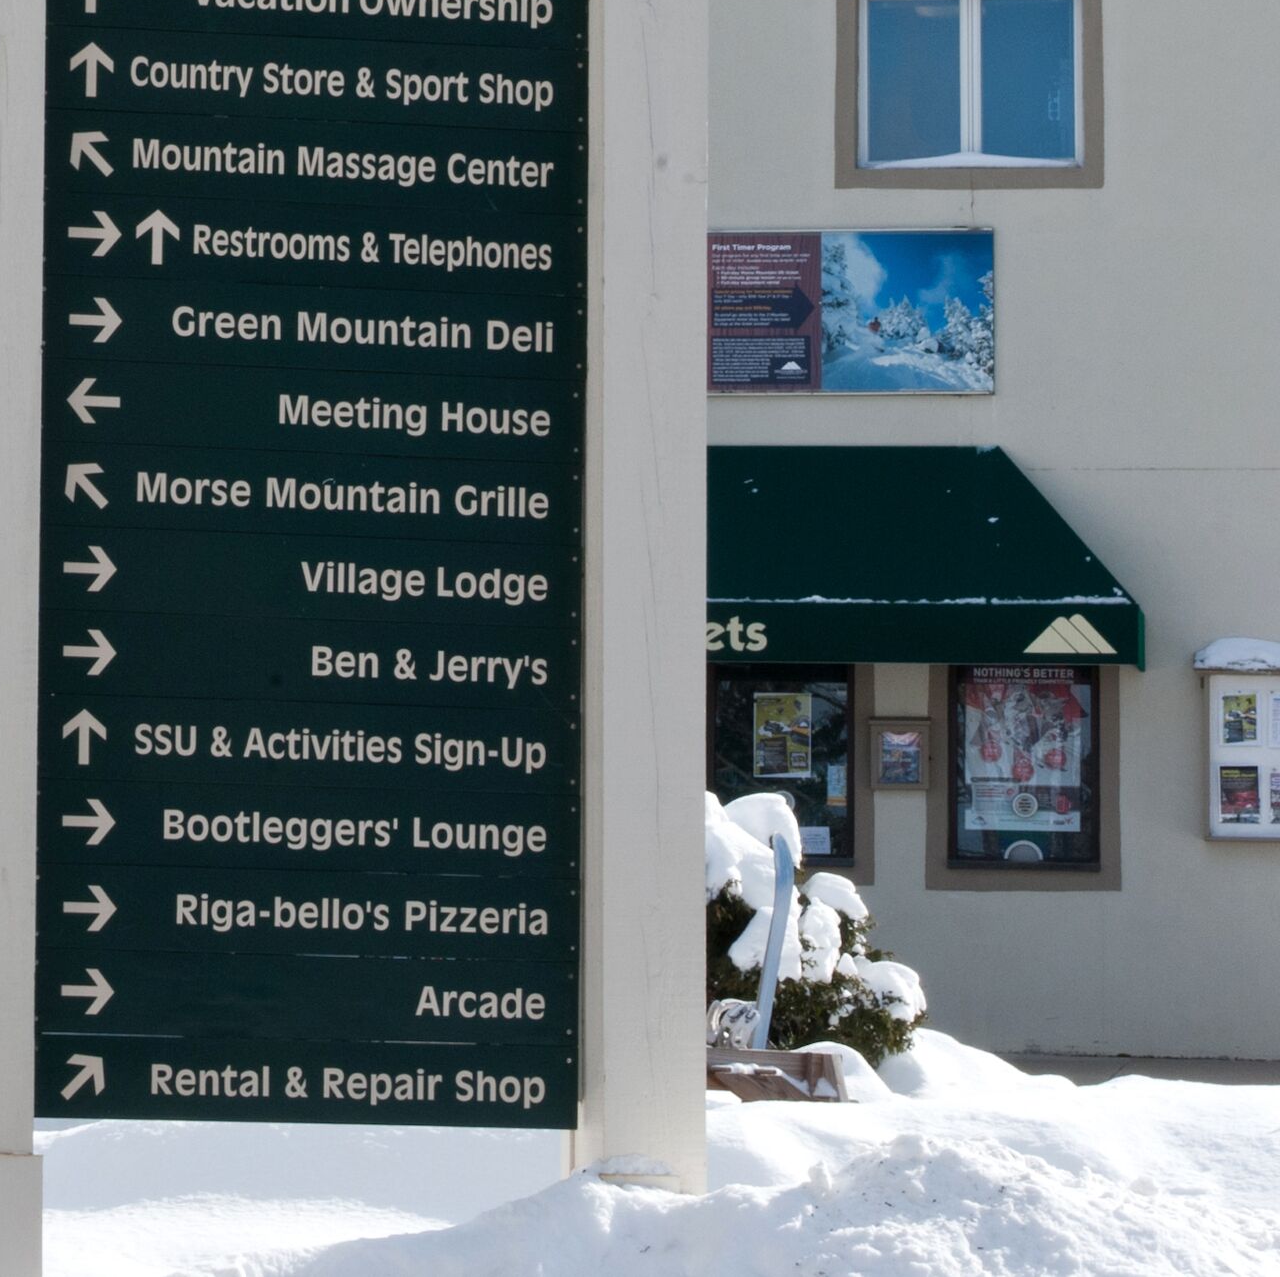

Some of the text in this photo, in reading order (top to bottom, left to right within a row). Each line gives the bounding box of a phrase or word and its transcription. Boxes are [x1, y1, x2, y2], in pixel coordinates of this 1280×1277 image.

[131, 56, 553, 111] Country Store & Sport Shop
[133, 138, 553, 187] Mountain Massage Center
[194, 225, 551, 271] Restrooms & Telephones
[173, 306, 553, 352] Green Mountain Deli
[279, 394, 550, 436] Meeting House
[137, 472, 548, 518] Morse Mountain Grille
[302, 562, 547, 605] Village Lodge
[312, 646, 547, 689] Ben & Jerry's
[973, 668, 1074, 678] NOTHING'S BETTER
[135, 724, 546, 773] SSU & Activities Sign-Up
[164, 810, 546, 856] Bootleggers' Lounge
[177, 894, 547, 935] Riga-bello's Pizzeria
[416, 986, 545, 1019] Arcade
[151, 1064, 545, 1109] Rental & Repair Shop
